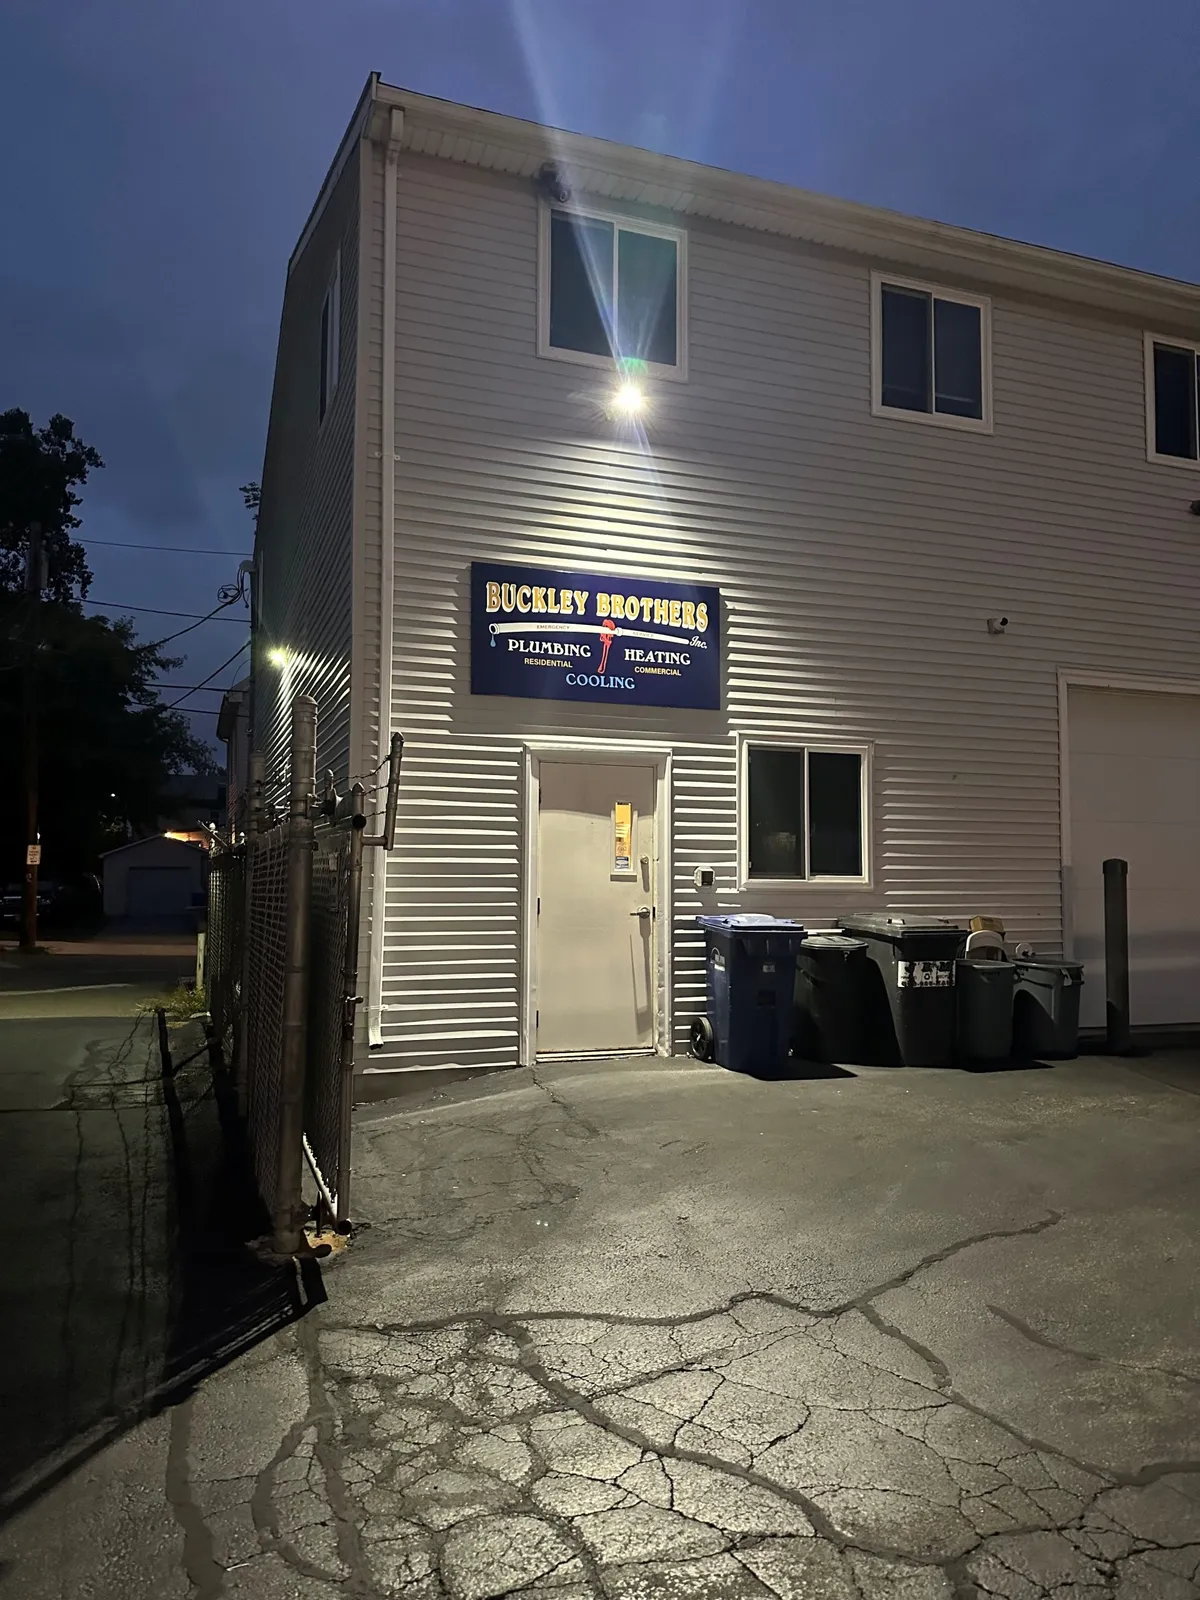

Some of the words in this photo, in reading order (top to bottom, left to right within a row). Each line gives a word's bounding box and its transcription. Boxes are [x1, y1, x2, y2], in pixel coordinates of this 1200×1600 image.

[486, 581, 589, 615] BUCKLEY
[596, 592, 708, 632] BROTHERS
[507, 638, 591, 657] PLUMBING
[689, 635, 708, 649] Inc.
[524, 657, 573, 668] RESIDENTIAL
[624, 648, 691, 665] HEATING
[634, 666, 682, 676] COMMERCIAL
[565, 673, 636, 689] COOLING
